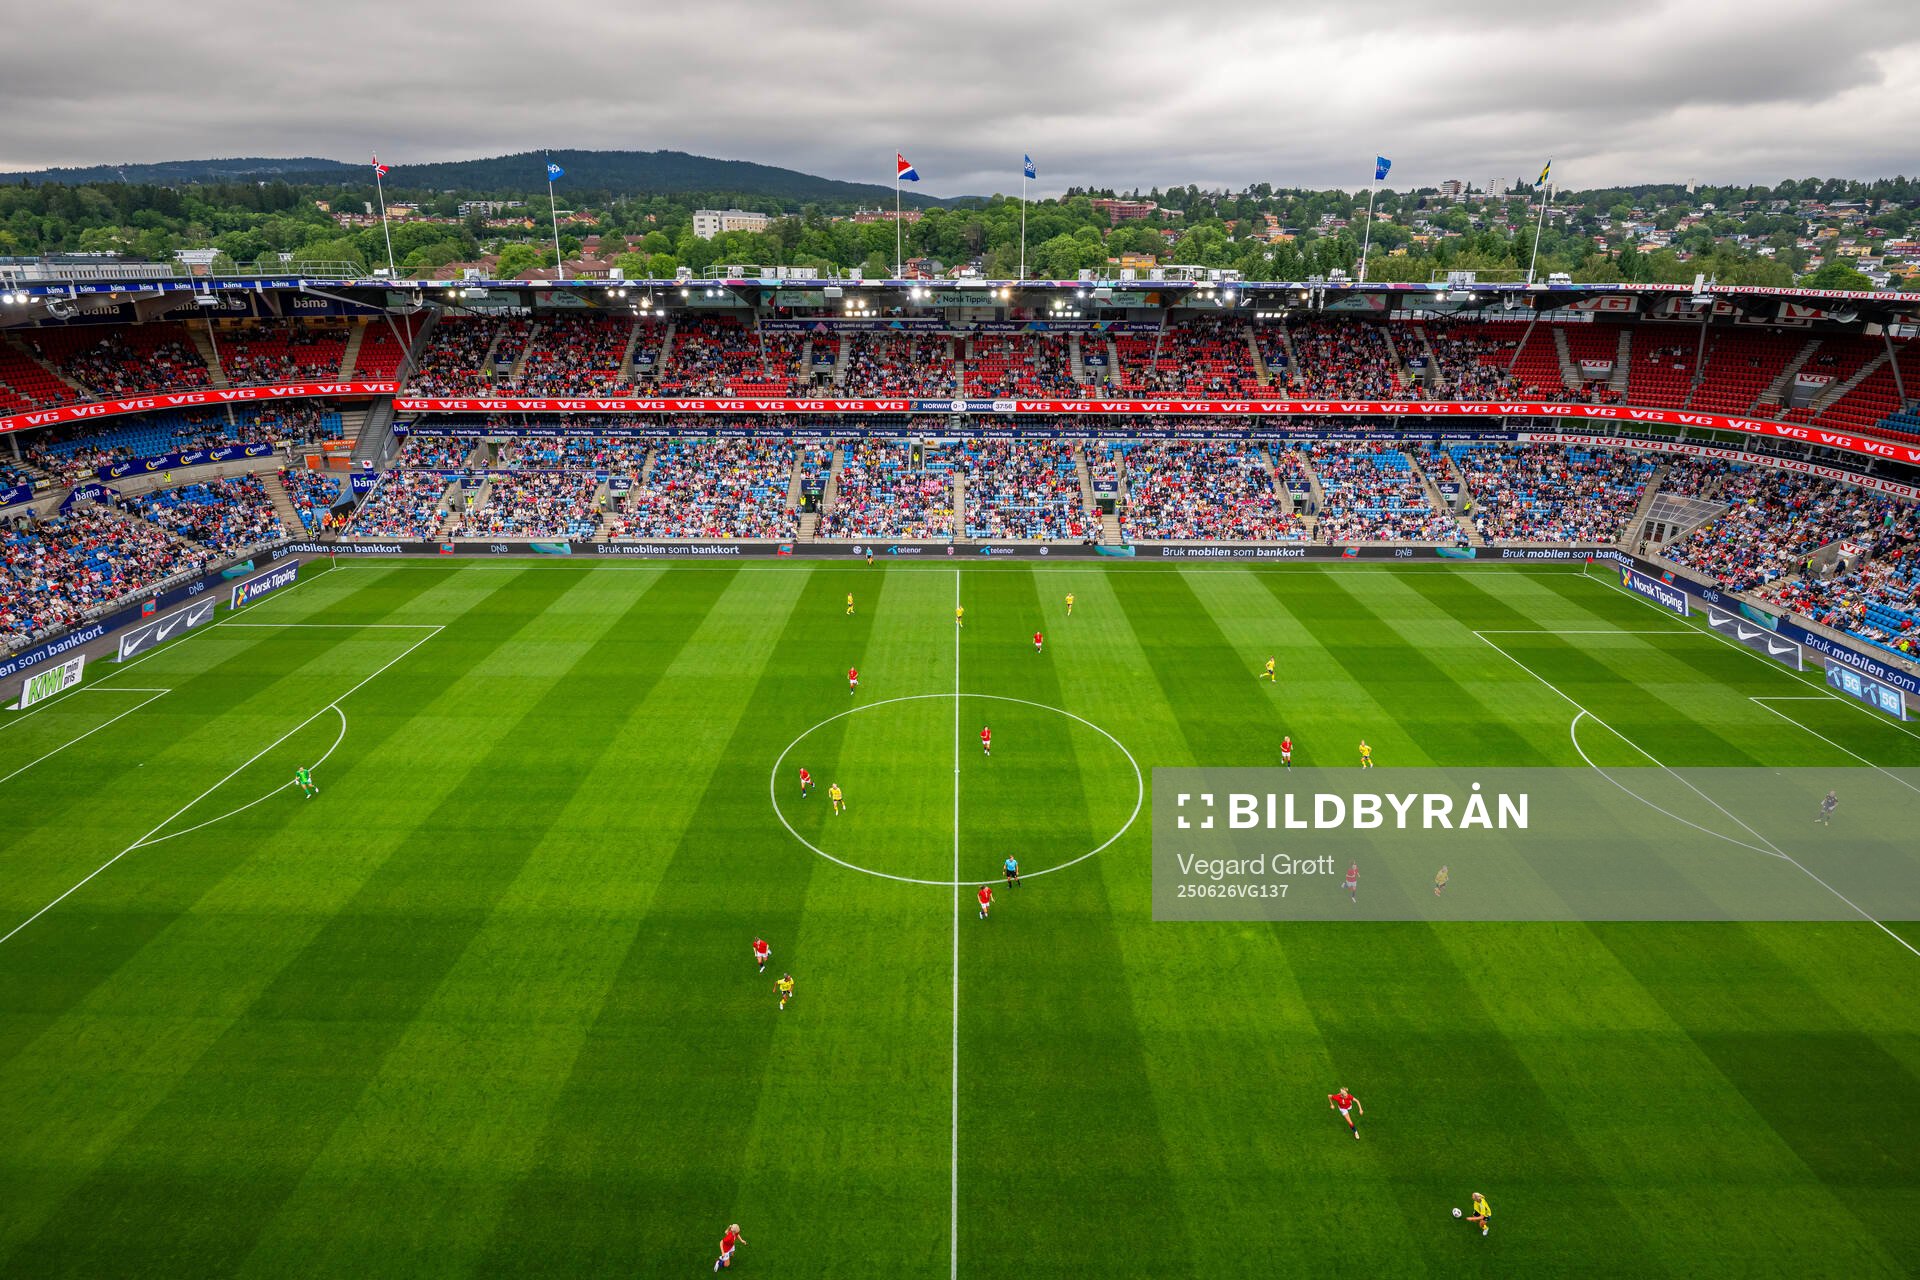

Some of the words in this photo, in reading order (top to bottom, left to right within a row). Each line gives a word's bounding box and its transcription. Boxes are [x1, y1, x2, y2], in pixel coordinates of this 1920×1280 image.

[46, 286, 64, 294] bama
[294, 297, 328, 308] bama
[966, 296, 992, 304] Tipping
[1801, 374, 1829, 383] VG
[26, 412, 58, 424] VG
[71, 406, 105, 417] VG
[118, 400, 154, 410] VG
[168, 394, 204, 404] VG
[219, 390, 255, 399] VG
[270, 387, 304, 396] VG
[318, 385, 351, 393] VG
[363, 384, 393, 392] VG
[400, 401, 428, 409] VG
[756, 402, 784, 410] VG
[796, 402, 824, 410] VG
[836, 402, 863, 410] VG
[875, 402, 903, 410] VG
[1022, 403, 1050, 411] VG
[1062, 403, 1090, 411] VG
[1222, 404, 1249, 412] VG
[1261, 404, 1289, 412] VG
[1301, 404, 1329, 412] VG
[1421, 405, 1448, 413] VG
[1584, 408, 1616, 417] VG
[1630, 411, 1663, 420] VG
[1679, 415, 1712, 425] VG
[1728, 420, 1761, 431] VG
[1776, 426, 1808, 439] VG
[1821, 434, 1851, 447] VG
[1864, 442, 1894, 456] VG
[115, 463, 130, 474] Bendit
[151, 457, 167, 468] Bendit
[185, 451, 203, 462] Bendit
[214, 448, 232, 458] Bendit
[250, 444, 266, 454] Bendit
[1598, 438, 1625, 446] VG
[1633, 440, 1661, 449] VG
[1670, 444, 1698, 453] VG
[1708, 448, 1736, 459] VG
[1744, 454, 1773, 465] VG
[1780, 460, 1808, 472] VG
[1816, 466, 1843, 479] VG
[1849, 474, 1876, 487] VG
[1883, 482, 1909, 495] VG
[354, 478, 376, 487] bam
[1, 489, 19, 502] Bendit
[74, 489, 100, 500] bama
[272, 546, 288, 560] Bruk
[289, 543, 329, 552] mobilen
[354, 544, 402, 553] bankkort
[491, 544, 508, 555] DNB
[598, 544, 621, 554] Bruk
[623, 544, 666, 554] mobilen
[691, 545, 740, 554] bankkort
[898, 546, 921, 554] telenor
[1163, 547, 1185, 556] Bruk
[1188, 548, 1230, 556] mobilen
[1257, 548, 1305, 557] bankkort
[1395, 547, 1412, 558] DNB
[1503, 549, 1524, 558] Bruk
[1528, 549, 1570, 558] mobilen
[1596, 550, 1634, 568] bankkort
[189, 582, 204, 596] DNB
[250, 580, 271, 597] Norsk
[271, 568, 296, 588] Tipping
[1634, 576, 1655, 597] Norsk
[1655, 585, 1682, 612] Tipping
[1703, 590, 1718, 602] DNB
[18, 652, 46, 668] som
[48, 625, 104, 656] bankkort
[66, 658, 79, 673] mini
[1805, 633, 1830, 654] Bruk
[1832, 648, 1884, 677] mobilen
[1886, 672, 1915, 691] som
[28, 666, 65, 704] KIWI
[64, 672, 75, 688] pris
[1845, 676, 1858, 692] 5G
[1882, 693, 1897, 710] 5G
